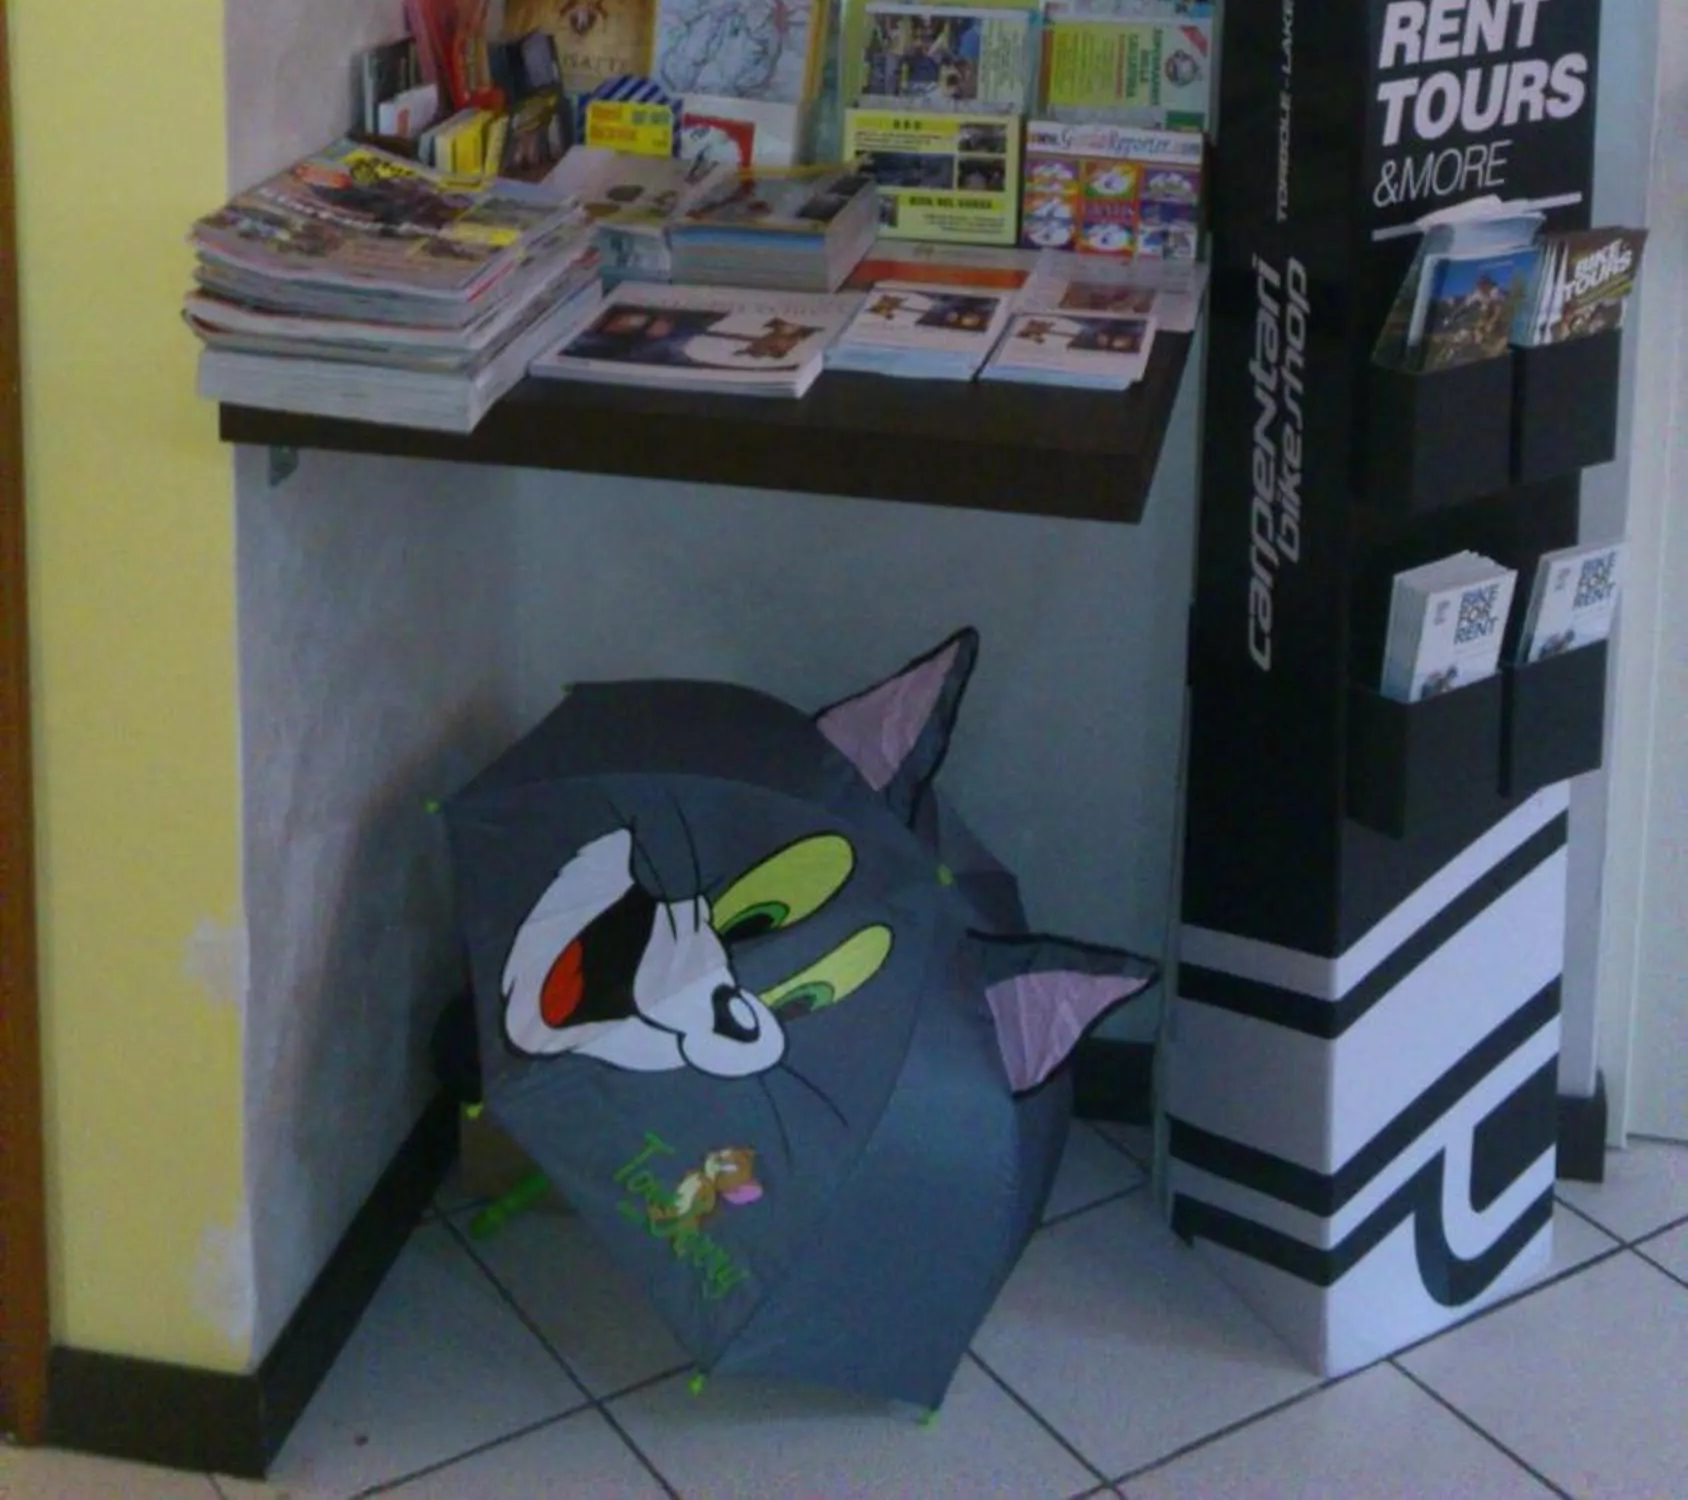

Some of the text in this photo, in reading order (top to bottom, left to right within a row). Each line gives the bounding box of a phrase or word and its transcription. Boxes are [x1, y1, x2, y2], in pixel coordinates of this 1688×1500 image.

[1377, 53, 1588, 146] TOURS
[1274, 92, 1292, 222] TORBOLE
[1372, 140, 1513, 208] &MORE
[1562, 250, 1632, 301] TOURS
[1575, 239, 1622, 279] BIKE
[1581, 550, 1617, 578] BIKE
[1461, 583, 1499, 607] BIKE
[1573, 579, 1616, 608] RENT
[1453, 616, 1499, 645] RENT
